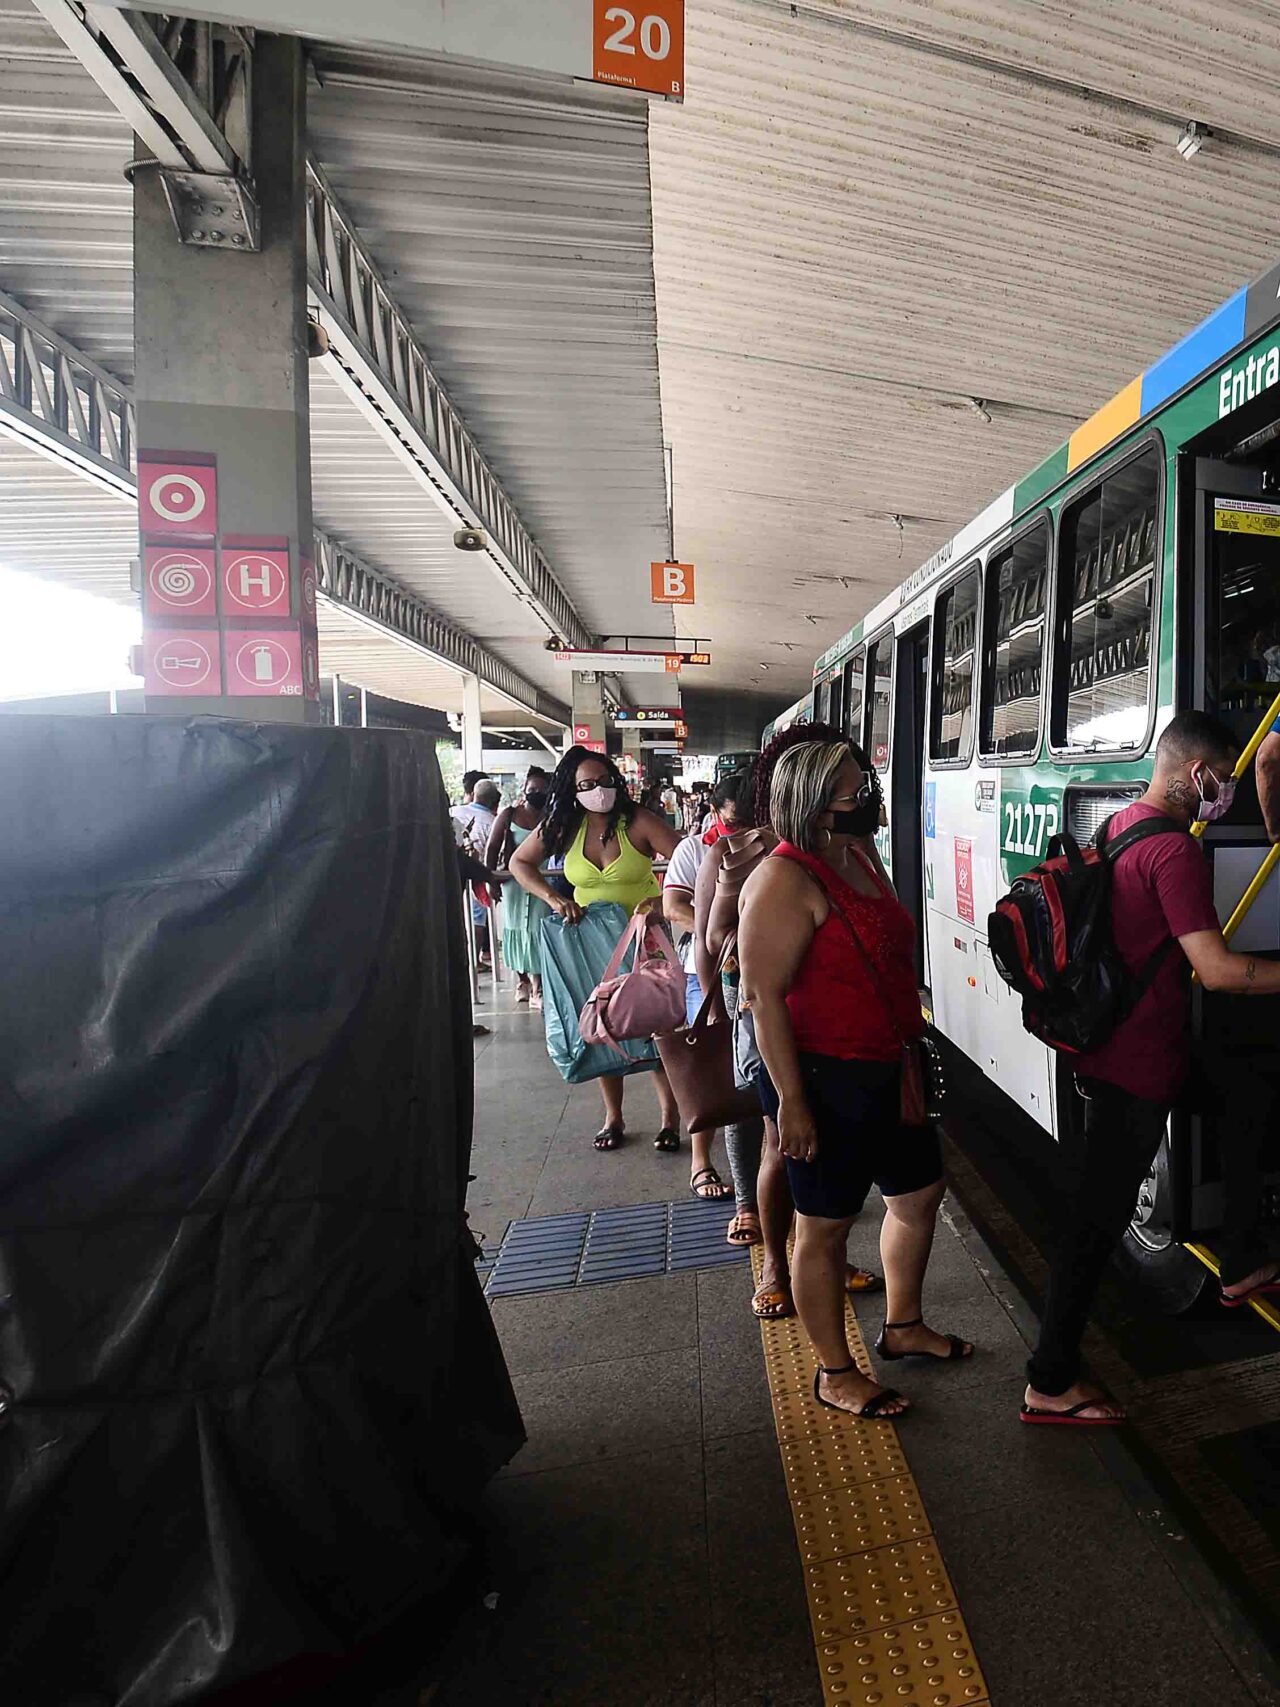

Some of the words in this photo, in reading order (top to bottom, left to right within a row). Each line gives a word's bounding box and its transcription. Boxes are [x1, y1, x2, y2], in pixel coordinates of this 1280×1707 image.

[603, 8, 671, 60] 20
[671, 81, 680, 92] B
[240, 565, 271, 597] H
[663, 567, 686, 597] B
[667, 659, 679, 668] 19
[279, 685, 302, 695] ABC
[648, 711, 669, 719] Saída
[678, 726, 685, 736] B
